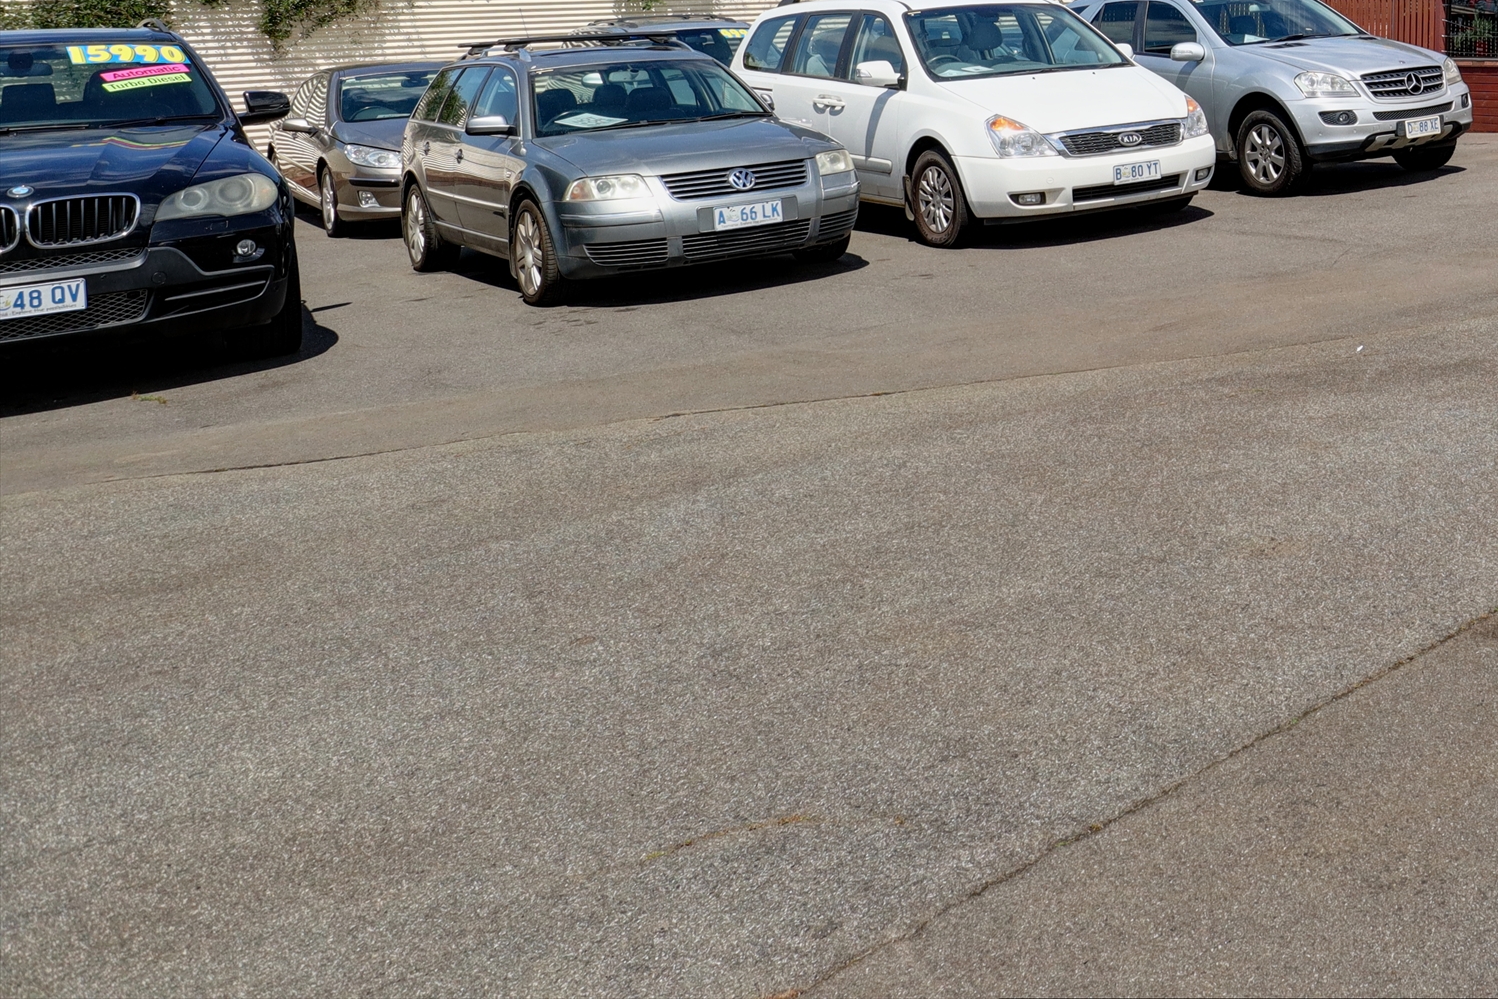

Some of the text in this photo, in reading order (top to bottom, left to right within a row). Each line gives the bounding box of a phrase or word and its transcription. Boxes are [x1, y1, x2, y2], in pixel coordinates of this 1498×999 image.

[68, 44, 186, 64] 15990
[112, 64, 182, 80] Automatic
[109, 74, 187, 90] Turbo Diesel
[1122, 134, 1139, 143] KIA
[1115, 167, 1122, 180] B
[1131, 164, 1144, 178] 80
[1146, 162, 1158, 175] YT
[718, 210, 726, 225] A
[740, 206, 757, 221] 66
[762, 202, 780, 218] LK
[13, 282, 80, 310] 48 QV
